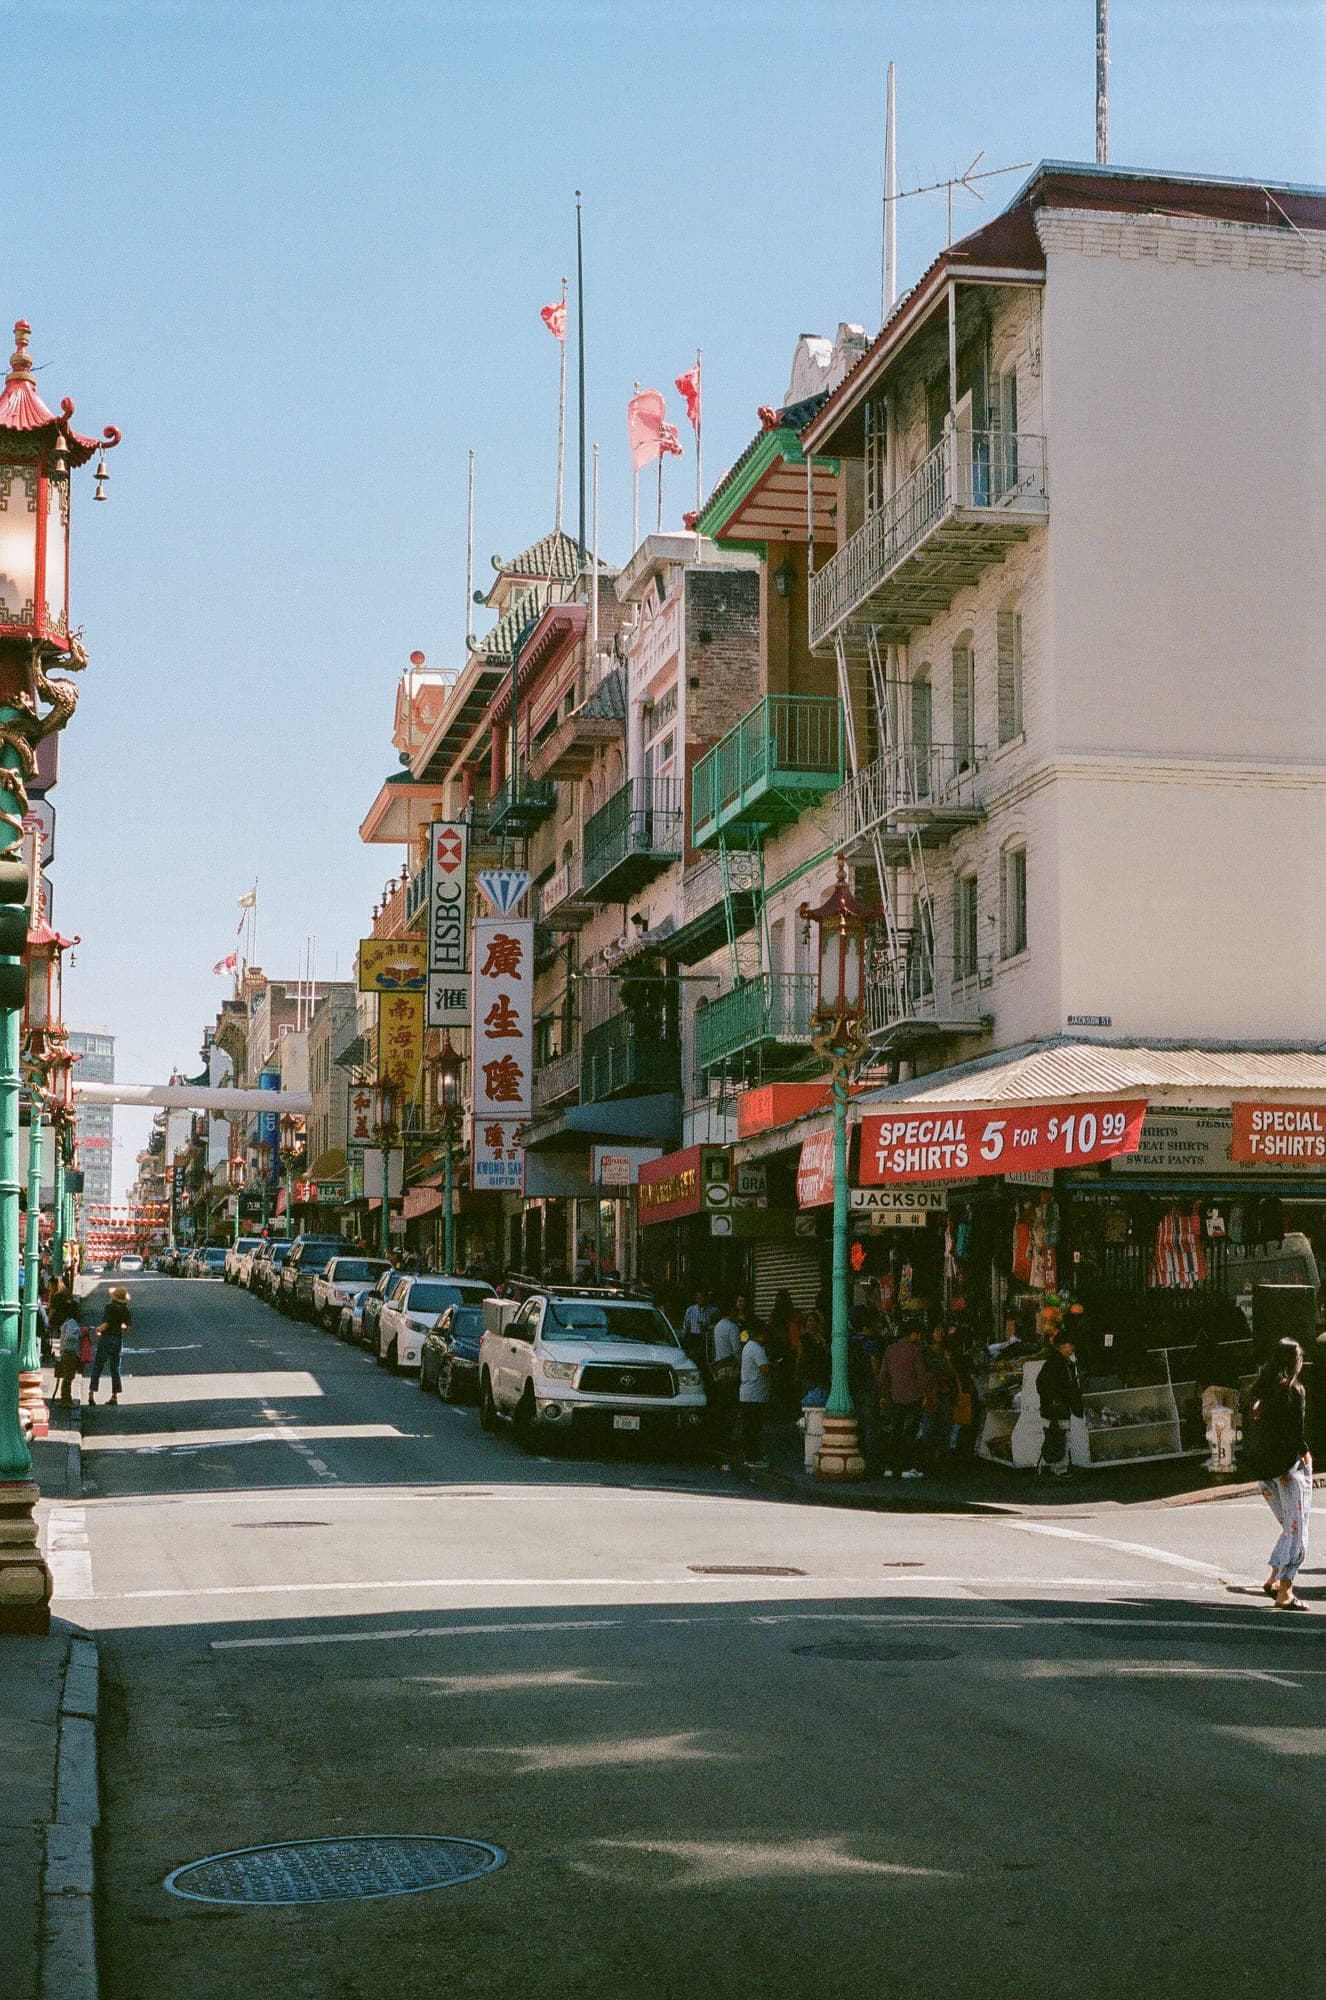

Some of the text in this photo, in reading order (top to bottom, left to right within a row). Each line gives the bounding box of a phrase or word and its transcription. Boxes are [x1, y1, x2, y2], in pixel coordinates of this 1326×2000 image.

[434, 881, 461, 966] HSBC
[1070, 1016, 1100, 1025] JACKSON
[1251, 1110, 1323, 1132] SPECIAL
[878, 1119, 966, 1146] SPECIAL
[1141, 1127, 1178, 1136] HIRTS
[979, 1121, 1007, 1161] 5
[1012, 1128, 1039, 1147] FOR
[1167, 1142, 1209, 1151] SHIRTS
[1249, 1134, 1326, 1156] T-SHIRTS
[875, 1144, 968, 1174] T-SHIRTS
[1126, 1154, 1204, 1164] SWEAT PANTS
[476, 1161, 505, 1175] KWONG
[489, 1176, 515, 1186] GIFTS
[854, 1193, 942, 1207] JACKSON
